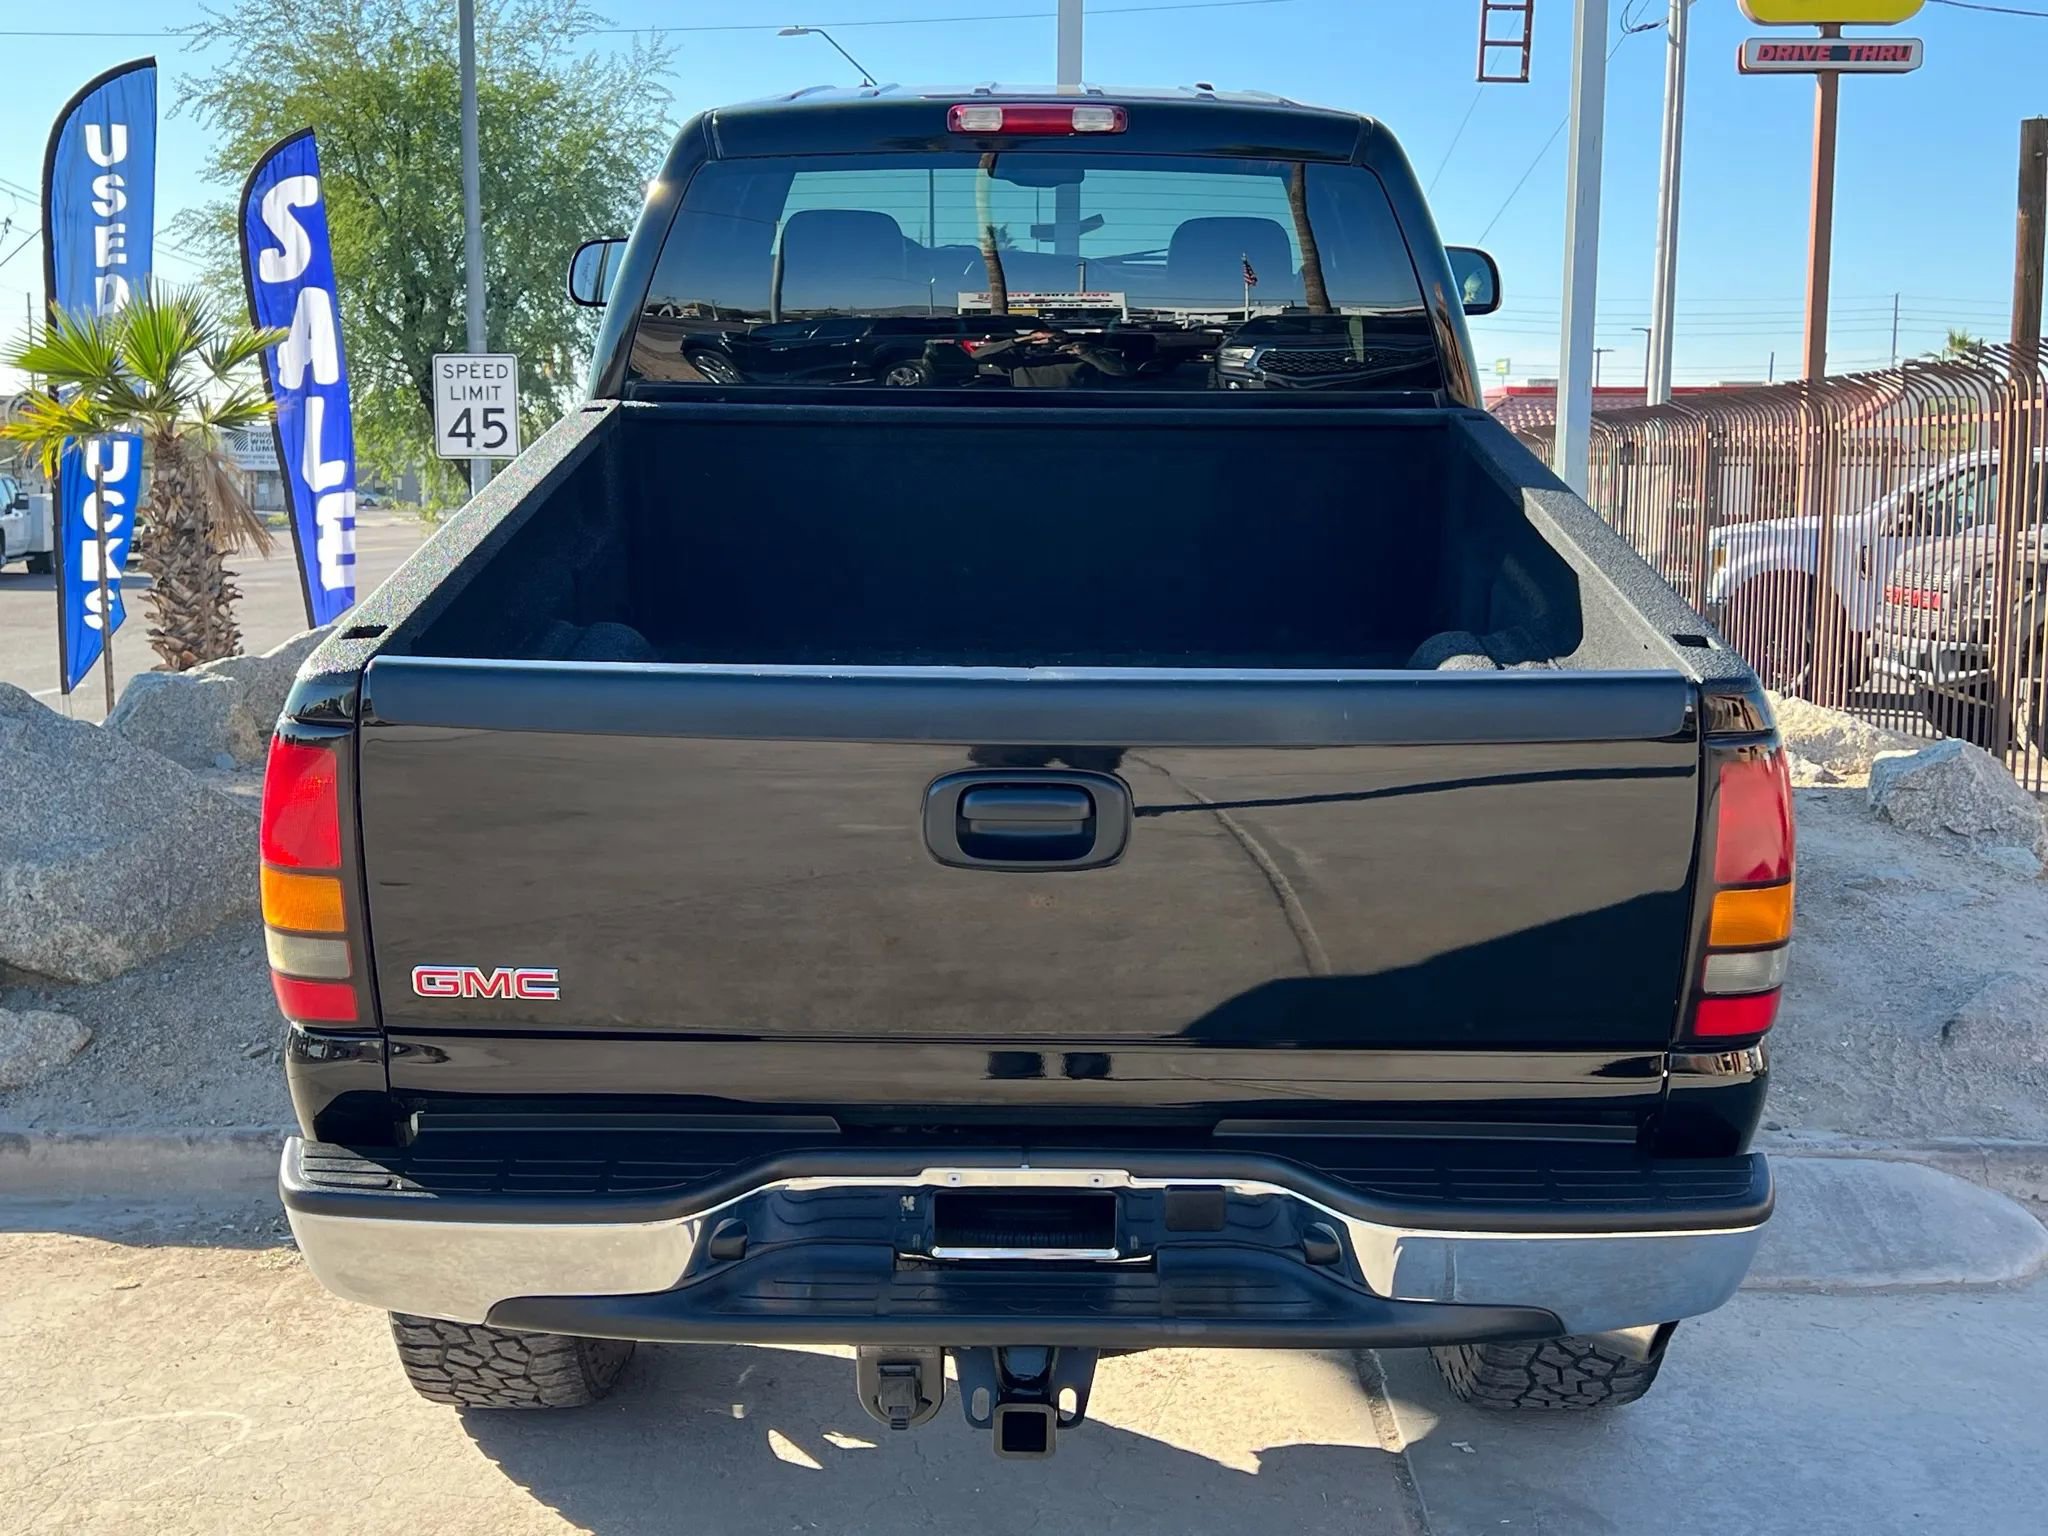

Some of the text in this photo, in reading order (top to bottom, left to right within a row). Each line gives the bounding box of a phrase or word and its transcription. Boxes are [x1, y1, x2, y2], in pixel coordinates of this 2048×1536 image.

[1757, 45, 1913, 62] DRIVE THRU
[81, 123, 130, 630] USED UCKS
[258, 175, 355, 591] SALE
[443, 363, 508, 379] SPEED
[450, 385, 501, 400] LIMIT
[448, 407, 508, 448] 45
[412, 965, 560, 1000] GMC
